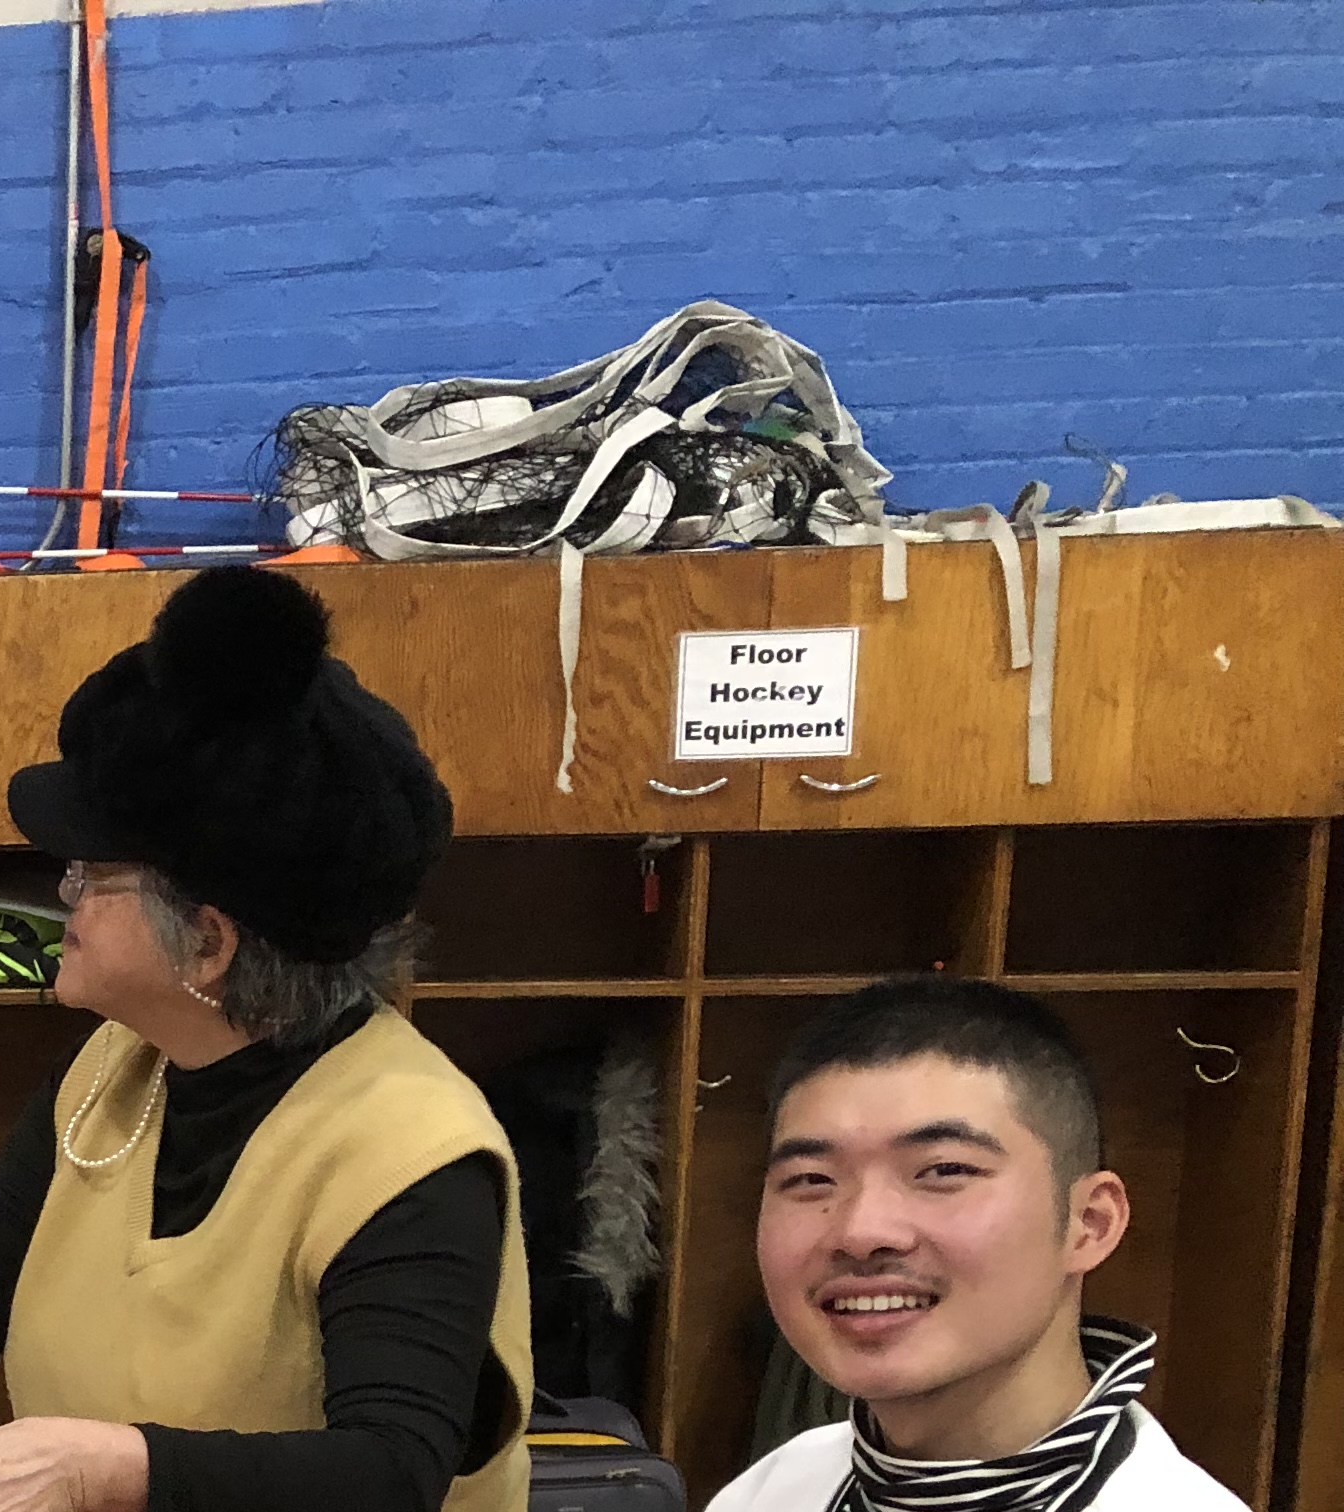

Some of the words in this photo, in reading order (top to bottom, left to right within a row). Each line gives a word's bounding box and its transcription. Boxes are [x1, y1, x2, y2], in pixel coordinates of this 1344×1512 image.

[729, 643, 808, 666] Floor
[709, 681, 824, 706] Hockey
[684, 716, 846, 745] Equipment
